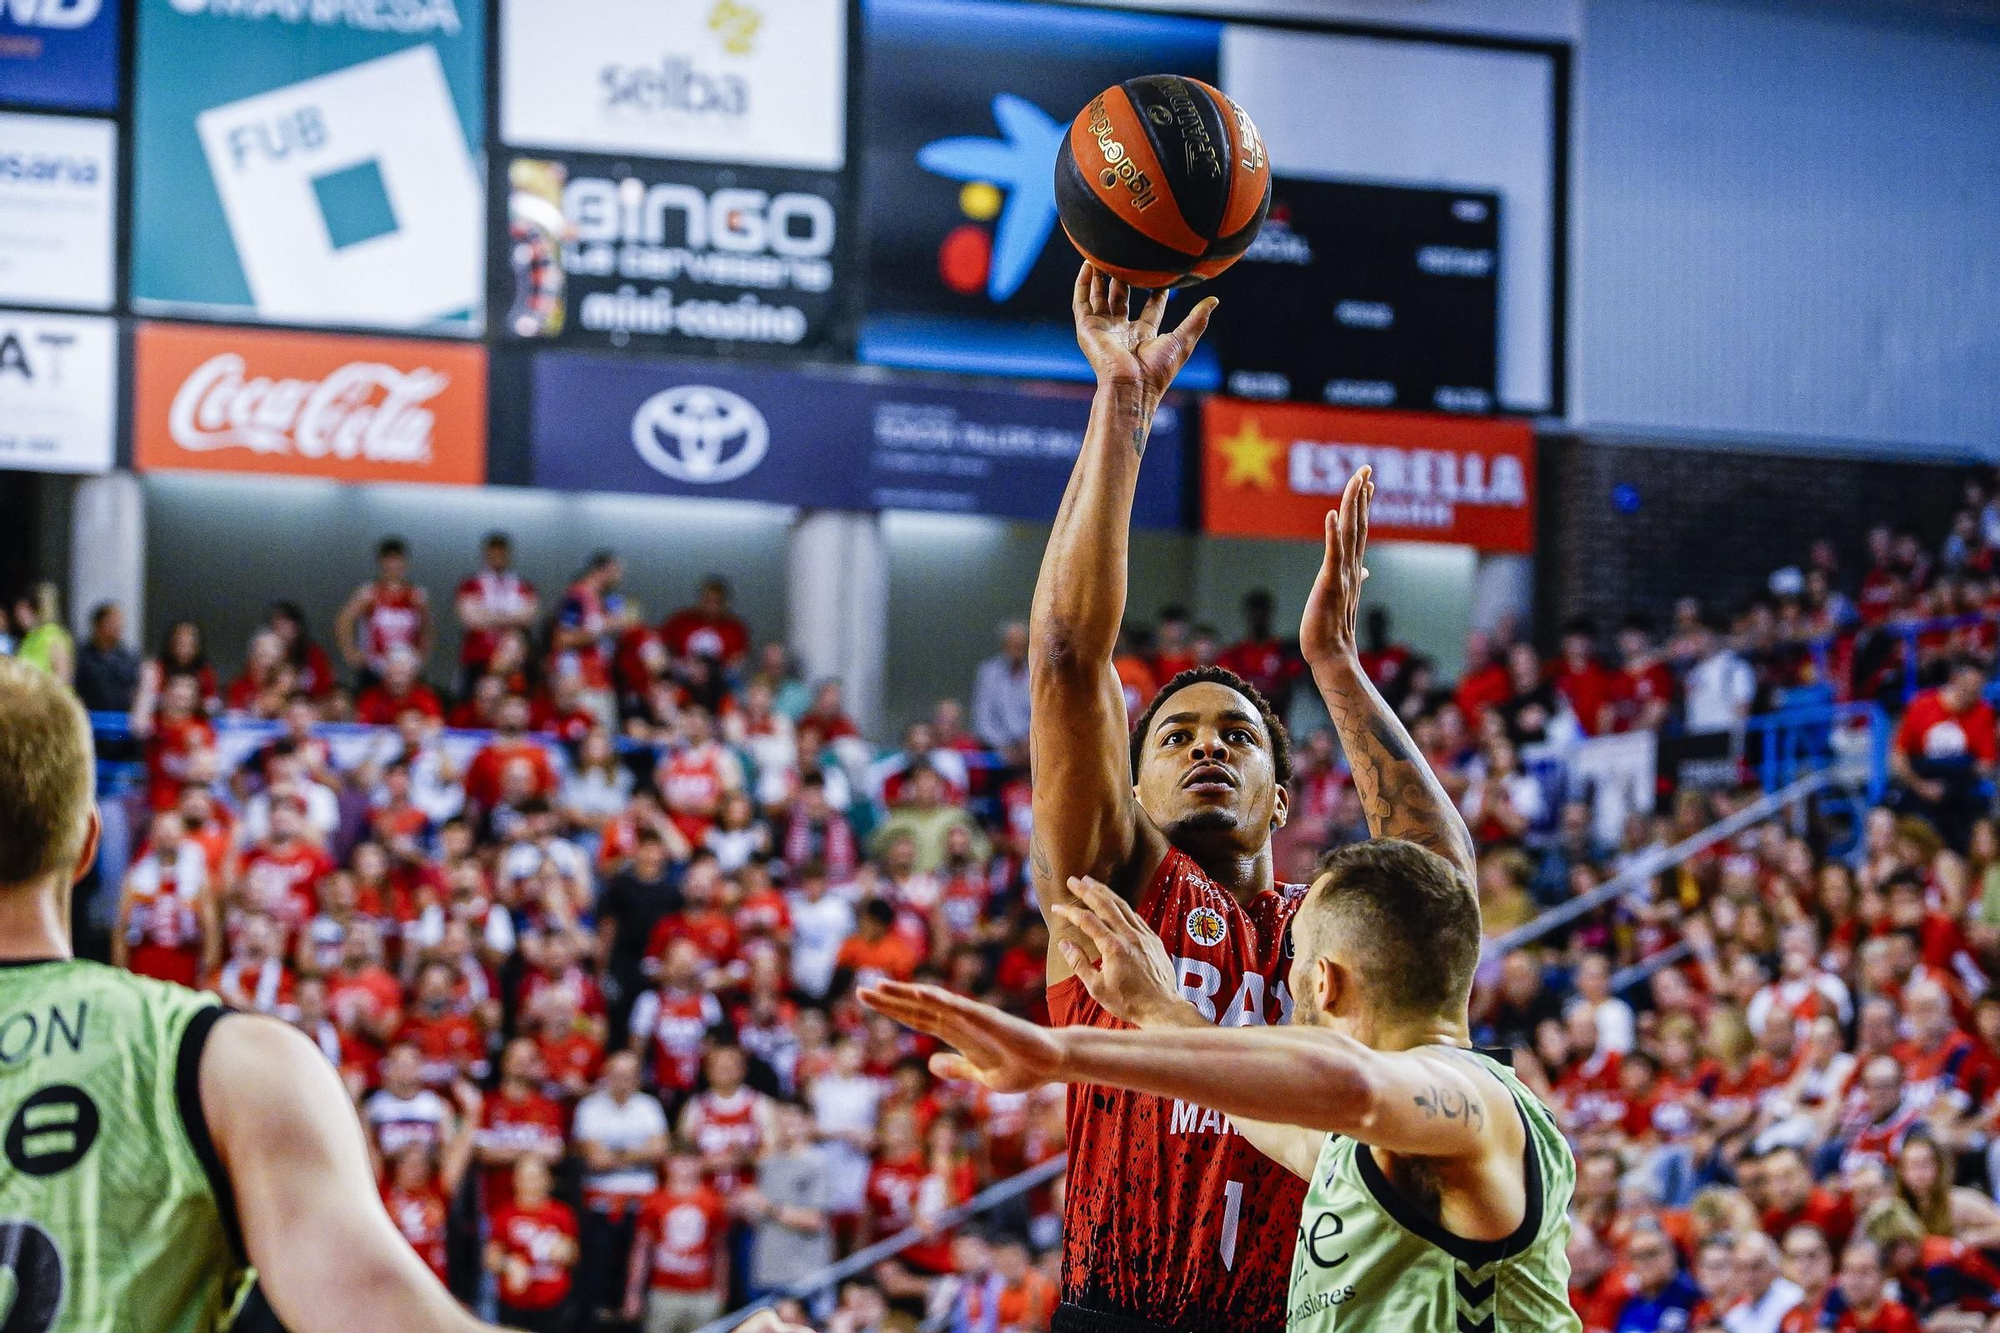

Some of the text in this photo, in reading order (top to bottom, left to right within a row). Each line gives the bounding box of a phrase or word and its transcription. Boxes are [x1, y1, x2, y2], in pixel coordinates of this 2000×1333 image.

[225, 105, 331, 168] FUB
[1287, 438, 1530, 508] ESTRELLA
[1220, 1179, 1244, 1272] 1
